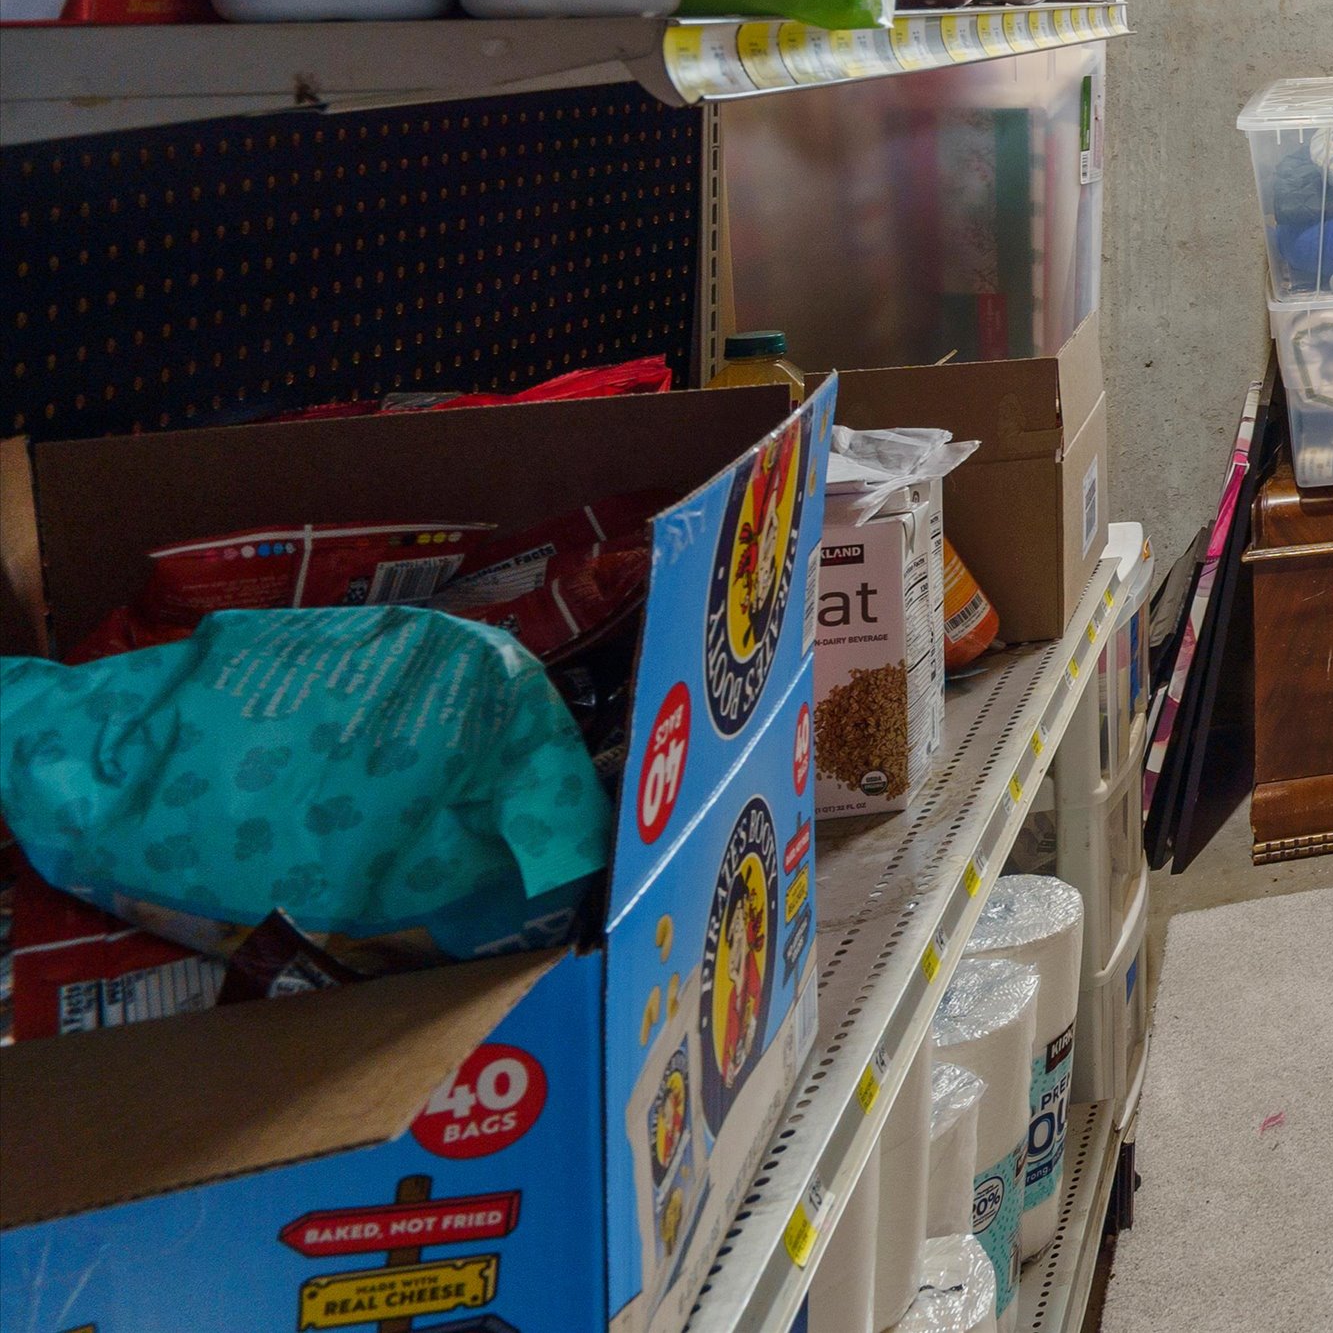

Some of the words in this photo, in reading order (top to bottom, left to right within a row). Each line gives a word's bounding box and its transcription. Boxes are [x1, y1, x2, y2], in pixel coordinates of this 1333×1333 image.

[817, 582, 878, 627] at
[814, 636, 847, 647] N-DAIRY
[848, 633, 889, 644] BEVERAGE
[654, 705, 684, 750] BAGS
[643, 736, 685, 830] 40
[748, 808, 779, 887] BOOTY
[423, 1057, 530, 1119] 40
[442, 1111, 518, 1145] BAGS
[304, 1223, 384, 1245] BAKED,
[390, 1215, 436, 1236] NOT
[441, 1210, 503, 1231] FRIED
[323, 1292, 378, 1317] REAL
[385, 1282, 467, 1306] CHEESE
[355, 1280, 397, 1295] MADE
[401, 1274, 440, 1289] WITH
